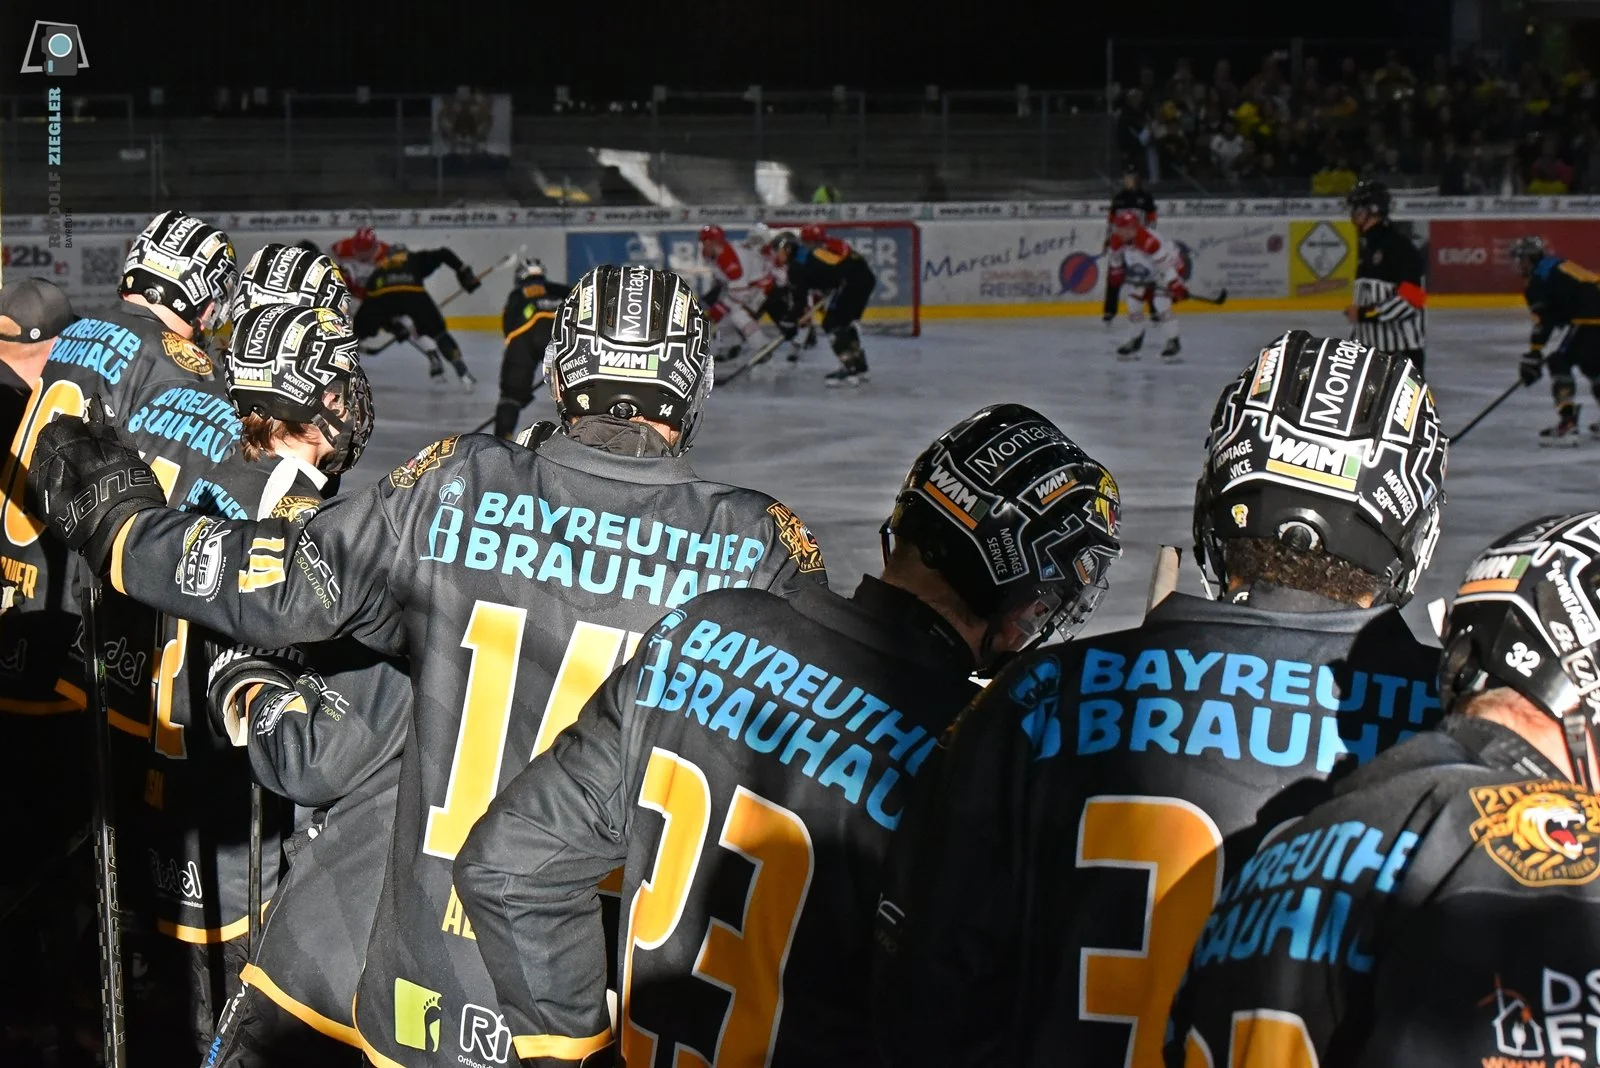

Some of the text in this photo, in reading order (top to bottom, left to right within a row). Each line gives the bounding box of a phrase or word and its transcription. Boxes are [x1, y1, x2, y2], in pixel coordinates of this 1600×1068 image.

[1438, 247, 1488, 266] ERGO
[234, 366, 265, 381] WAM
[562, 354, 589, 373] MONTAGE
[566, 367, 590, 383] SERVICE
[600, 350, 648, 370] WAM
[673, 358, 696, 384] MONTAGE
[280, 382, 305, 399] SERVICE
[283, 372, 312, 393] MONTAGE
[668, 370, 688, 392] SERVICE
[659, 403, 674, 418] 14
[1269, 434, 1346, 476] WAM
[928, 464, 979, 514] WAM
[1034, 471, 1069, 500] WAM
[1382, 468, 1413, 517] MONTAGE
[55, 466, 157, 539] AUER
[473, 490, 765, 574] BAYREUTHER
[186, 523, 213, 593] OCKEY
[986, 537, 1008, 576] SERVICE
[1000, 527, 1023, 575] MONTAGE
[296, 555, 333, 609] SOLUTIONS
[1505, 641, 1541, 679] 32
[1076, 697, 1418, 774] BRAUH
